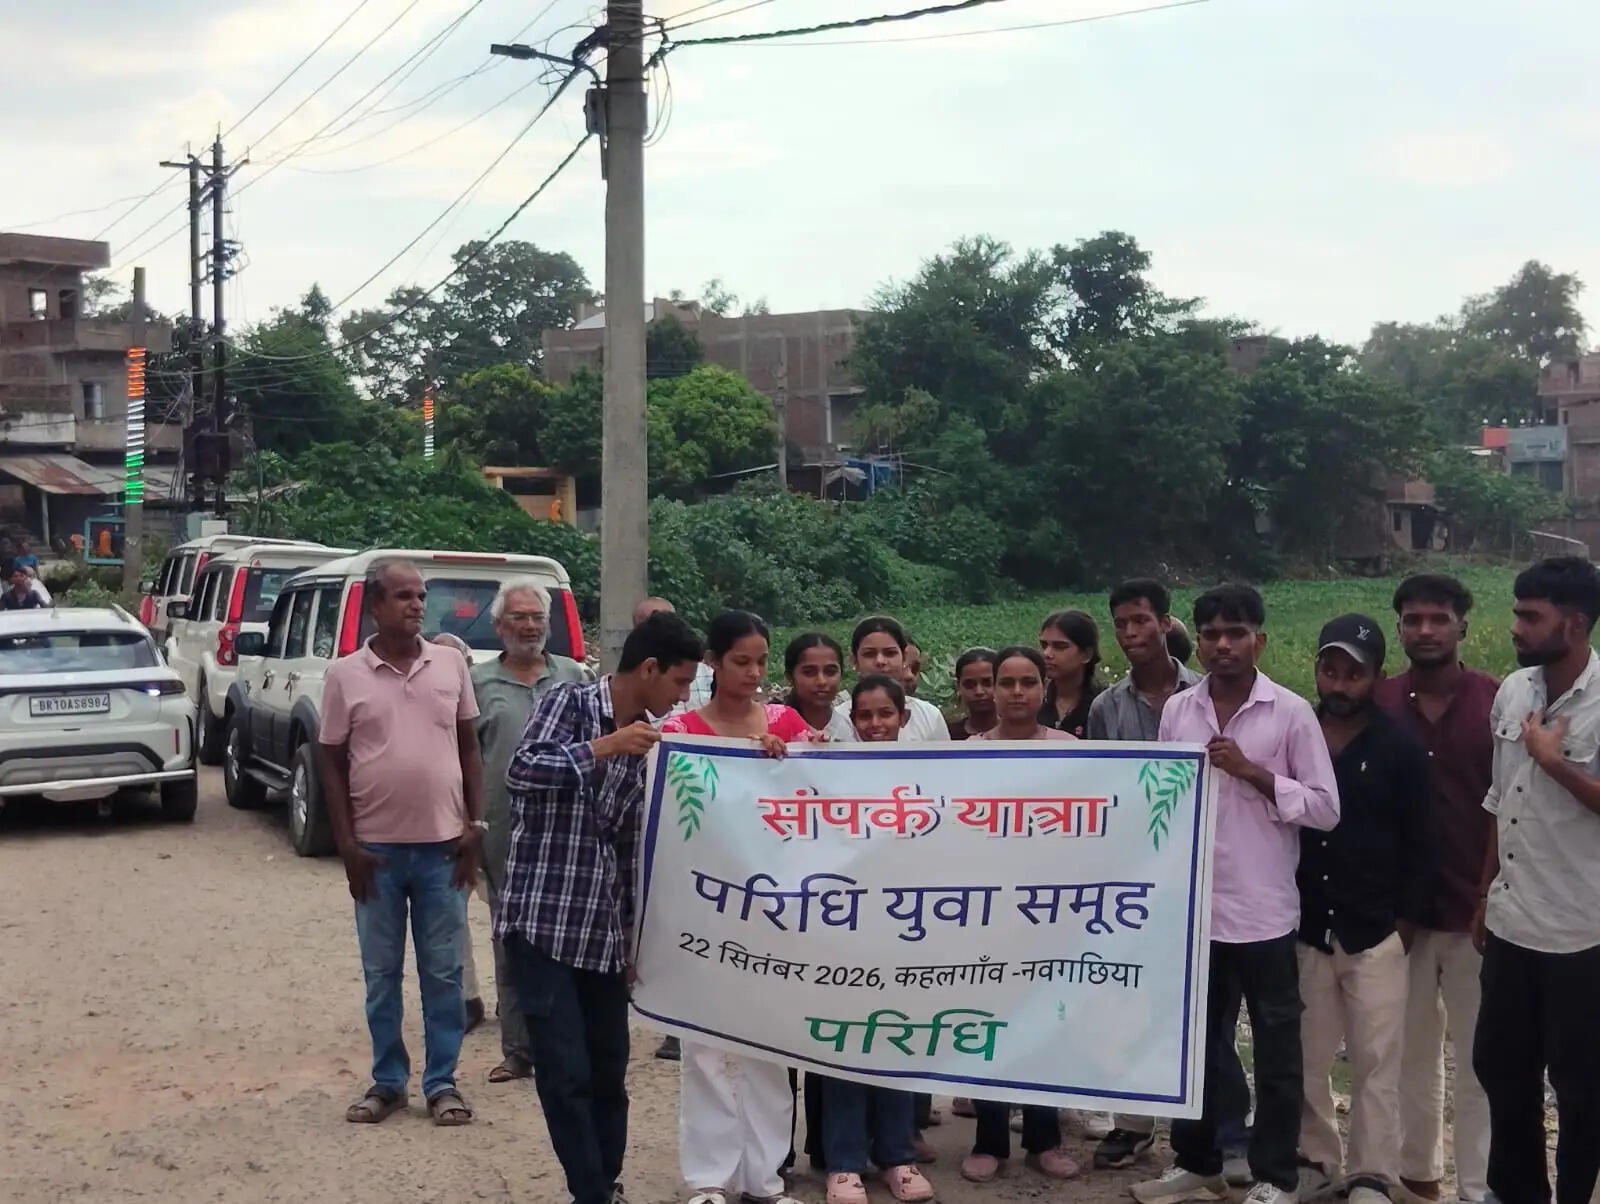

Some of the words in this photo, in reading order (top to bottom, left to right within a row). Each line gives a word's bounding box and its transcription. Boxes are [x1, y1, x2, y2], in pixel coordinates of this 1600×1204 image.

[757, 784, 945, 842] संपर्क
[951, 795, 1119, 838] यात्रा
[691, 869, 869, 933] परिधि
[882, 885, 1002, 941] युवा
[1015, 881, 1156, 934] समूह
[679, 932, 710, 959] 22
[718, 940, 810, 982] सितंबर
[814, 965, 885, 990] 2026,
[894, 954, 1009, 989] कहलगाँव
[804, 1008, 1009, 1061] परिधि
